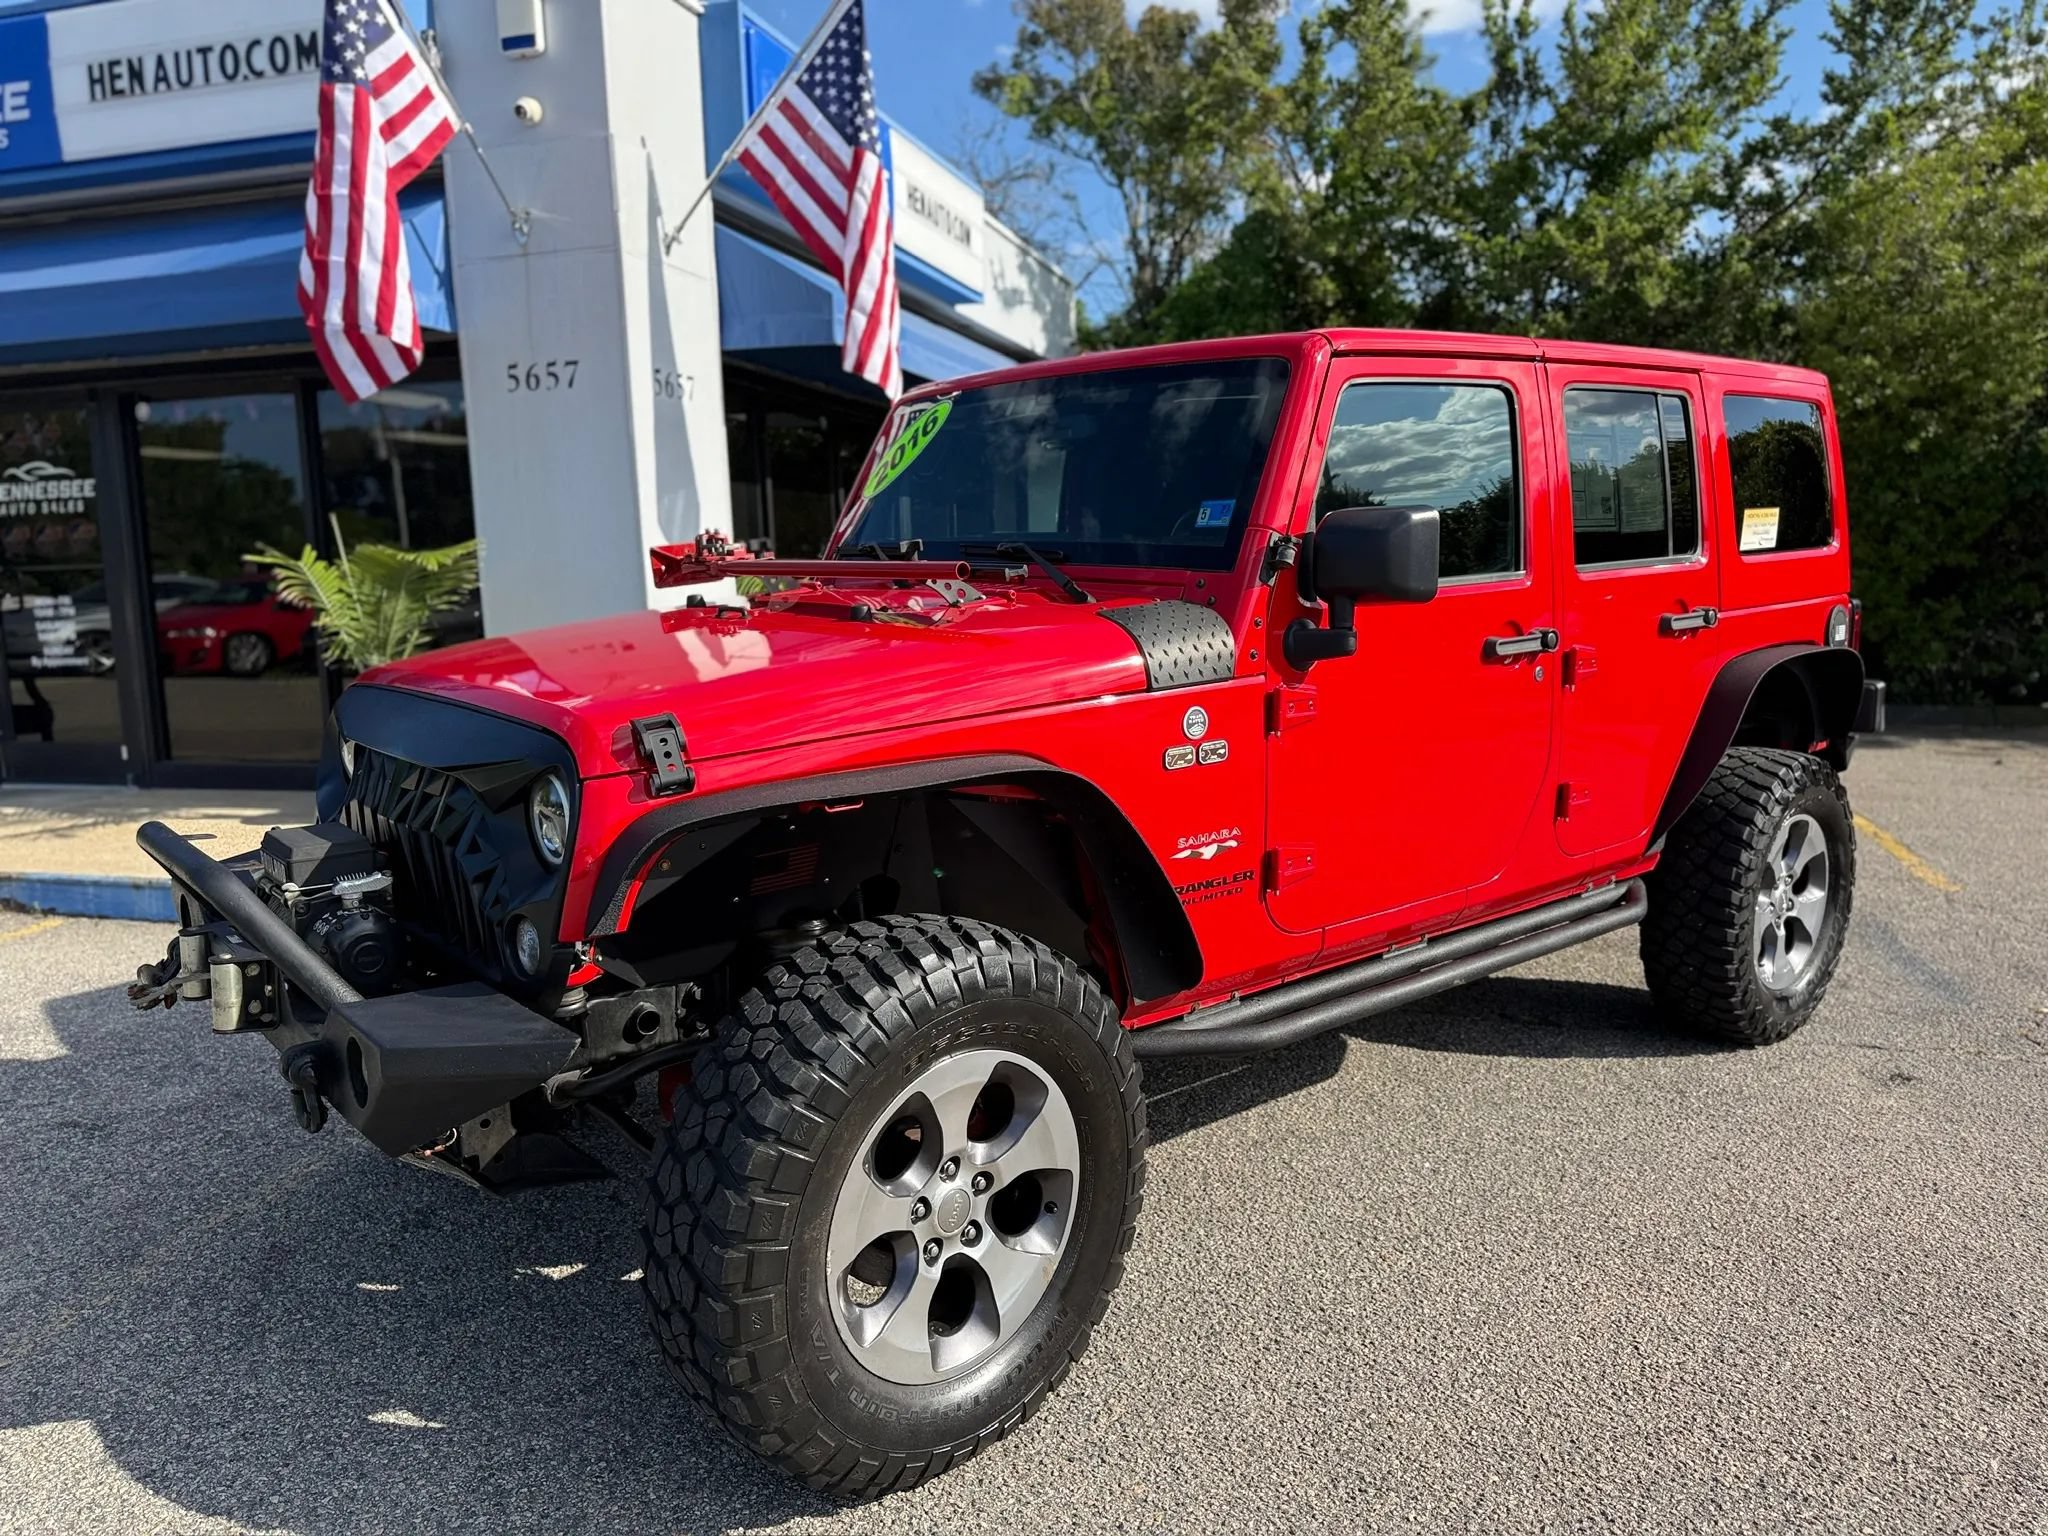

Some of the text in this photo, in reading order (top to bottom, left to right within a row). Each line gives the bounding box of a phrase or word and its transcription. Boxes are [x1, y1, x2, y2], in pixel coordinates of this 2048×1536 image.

[87, 30, 320, 102] HENAUTO.COM
[506, 359, 579, 393] 5657
[653, 367, 695, 401] 5657
[871, 409, 941, 493] 2016
[0, 478, 96, 501] ENNESSEE
[1177, 826, 1241, 849] SAHARA
[1174, 869, 1255, 896] RANGLER
[1181, 886, 1243, 905] NLIMITED
